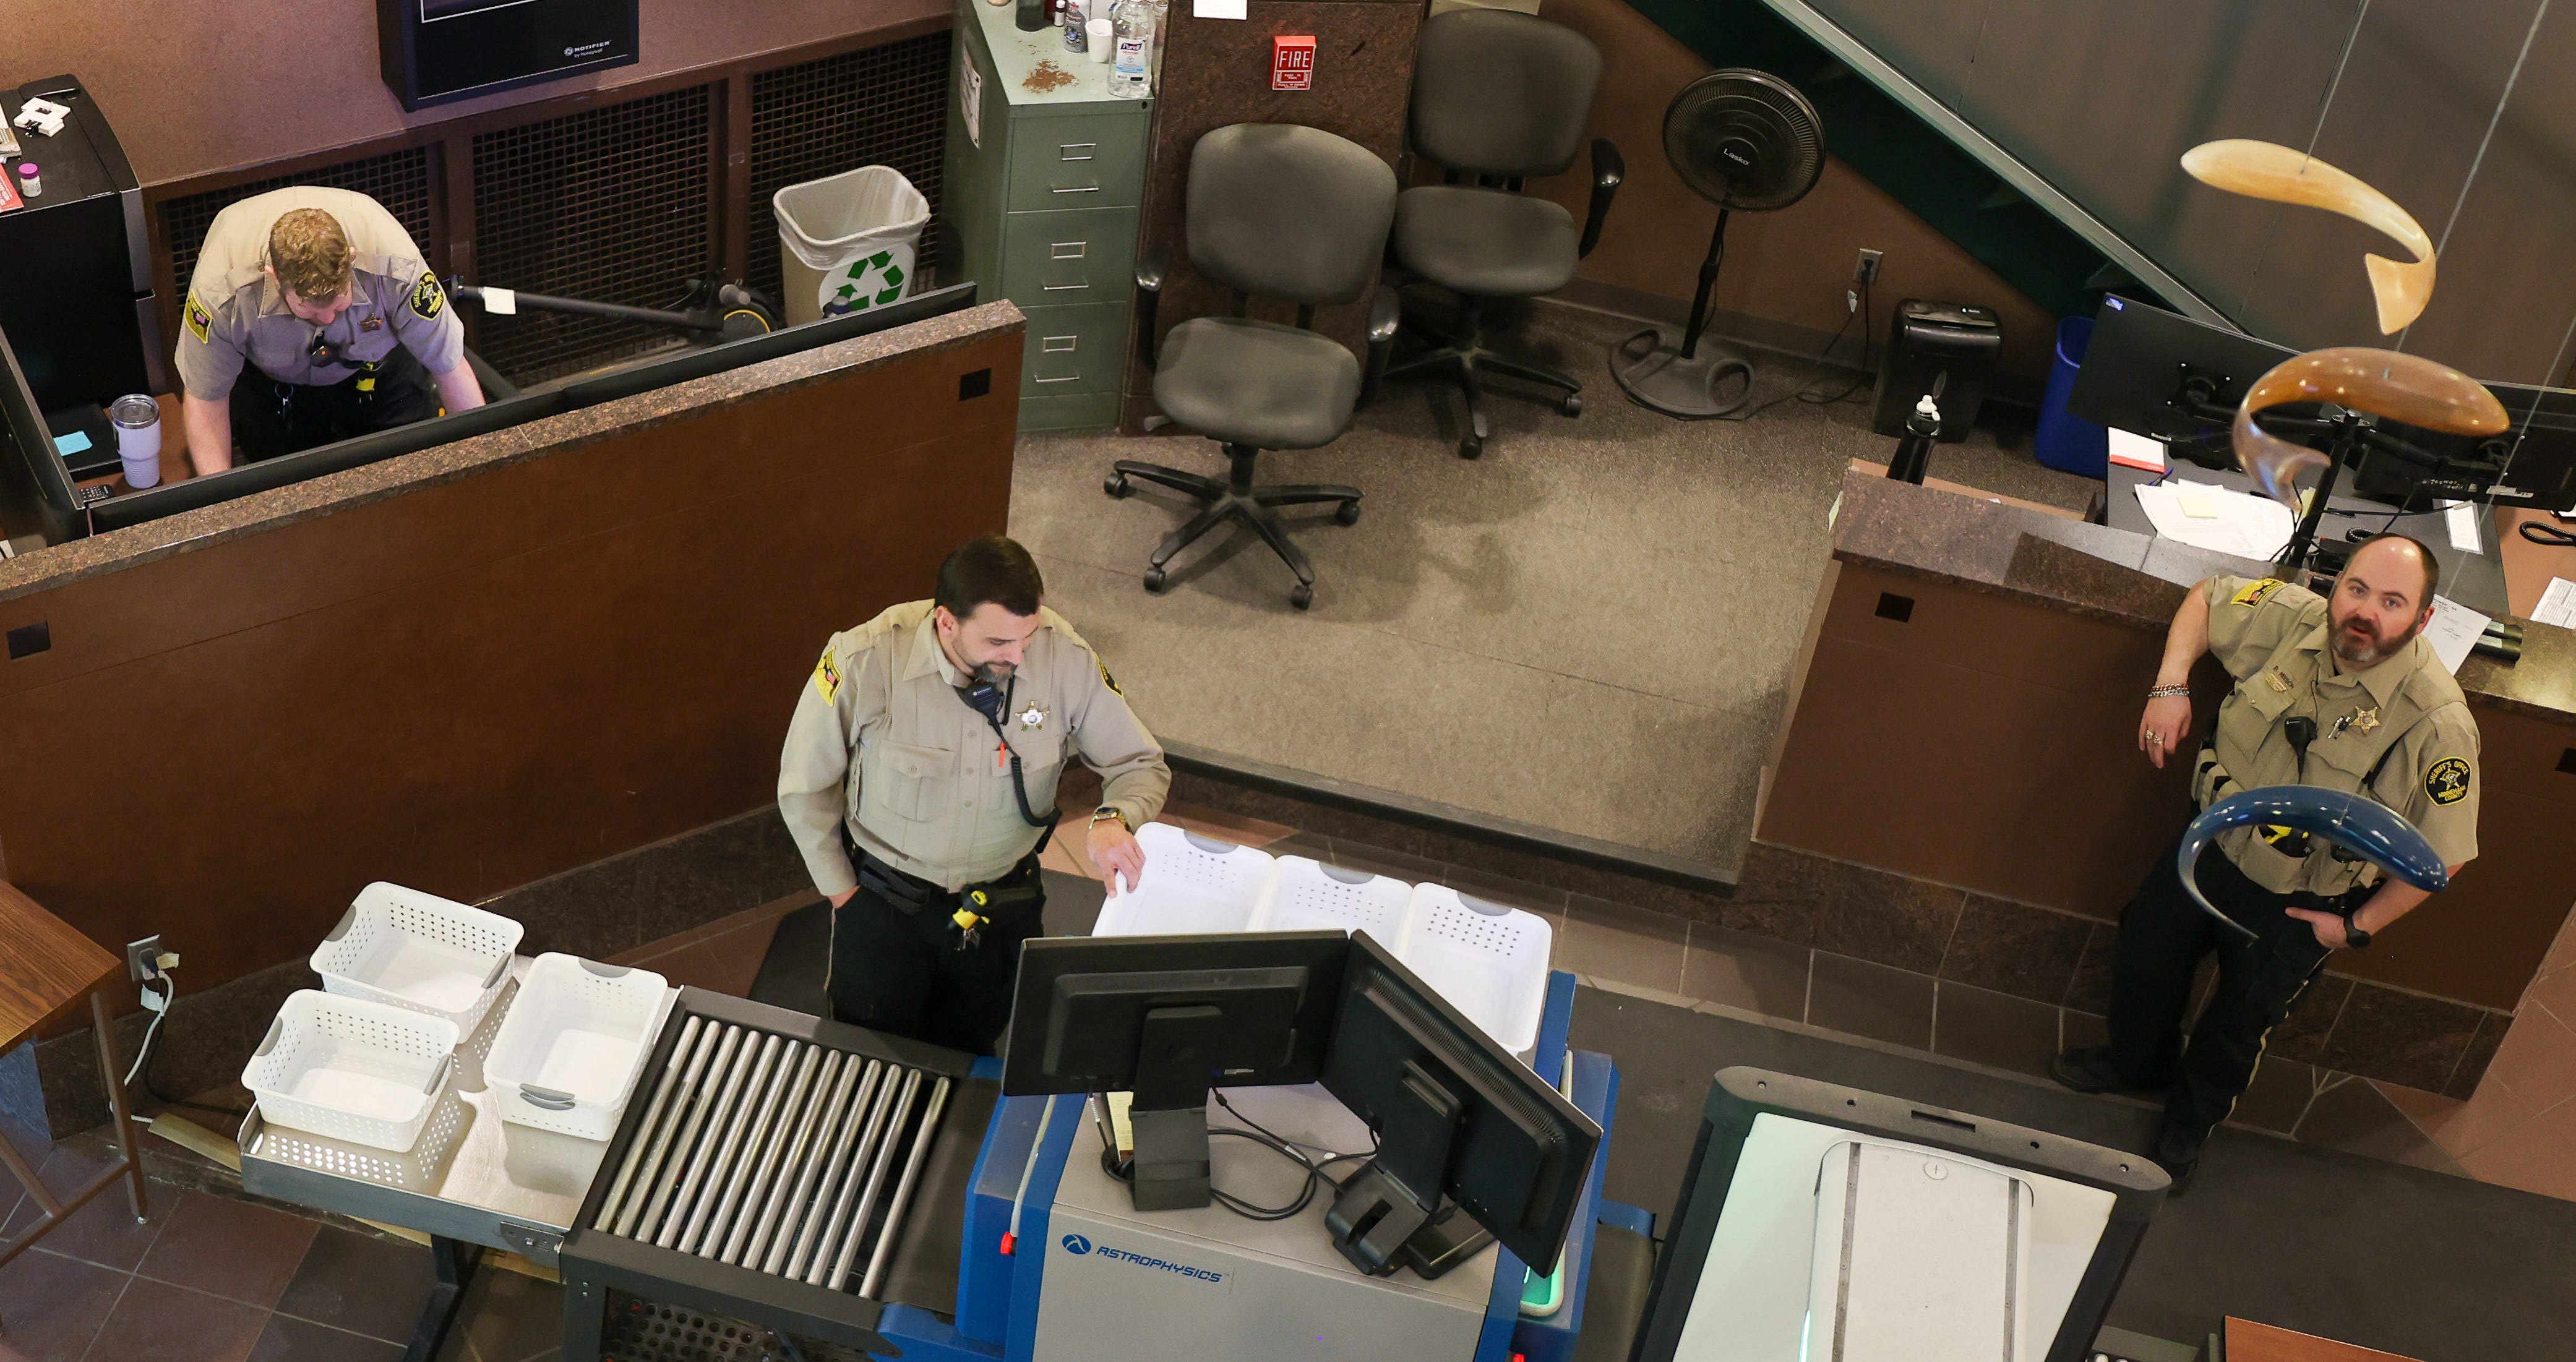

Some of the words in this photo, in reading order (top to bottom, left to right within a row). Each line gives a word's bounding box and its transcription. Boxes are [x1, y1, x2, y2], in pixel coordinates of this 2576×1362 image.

[574, 41, 610, 52] NOTIFIER
[1279, 51, 1311, 67] FIRE
[1723, 148, 1748, 166] Lasko
[2428, 761, 2452, 784] SHERIFF'S
[1096, 1246, 1222, 1283] ASTROPHYSICS
